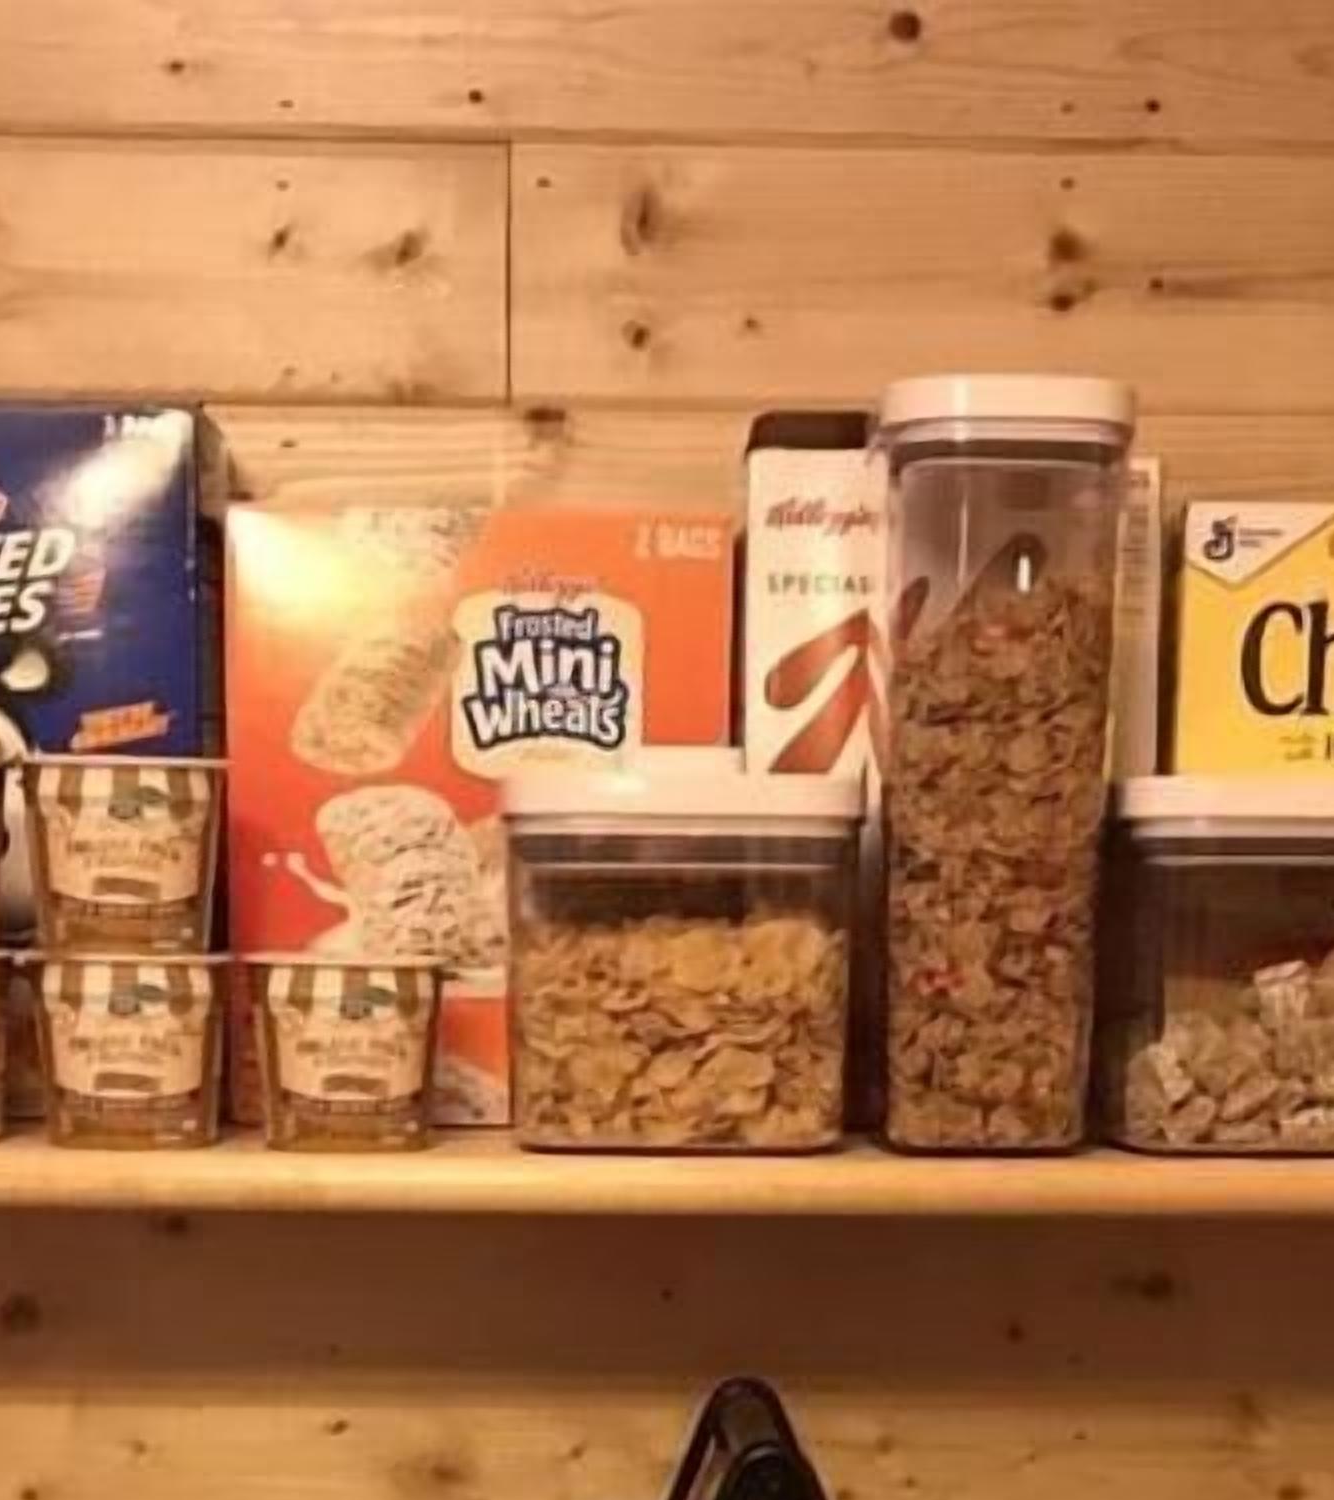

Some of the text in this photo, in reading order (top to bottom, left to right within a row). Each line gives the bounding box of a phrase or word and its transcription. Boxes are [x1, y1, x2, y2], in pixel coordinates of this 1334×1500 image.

[498, 608, 596, 642] Frosted
[479, 638, 616, 698] Mini
[468, 687, 622, 745] Wheats
